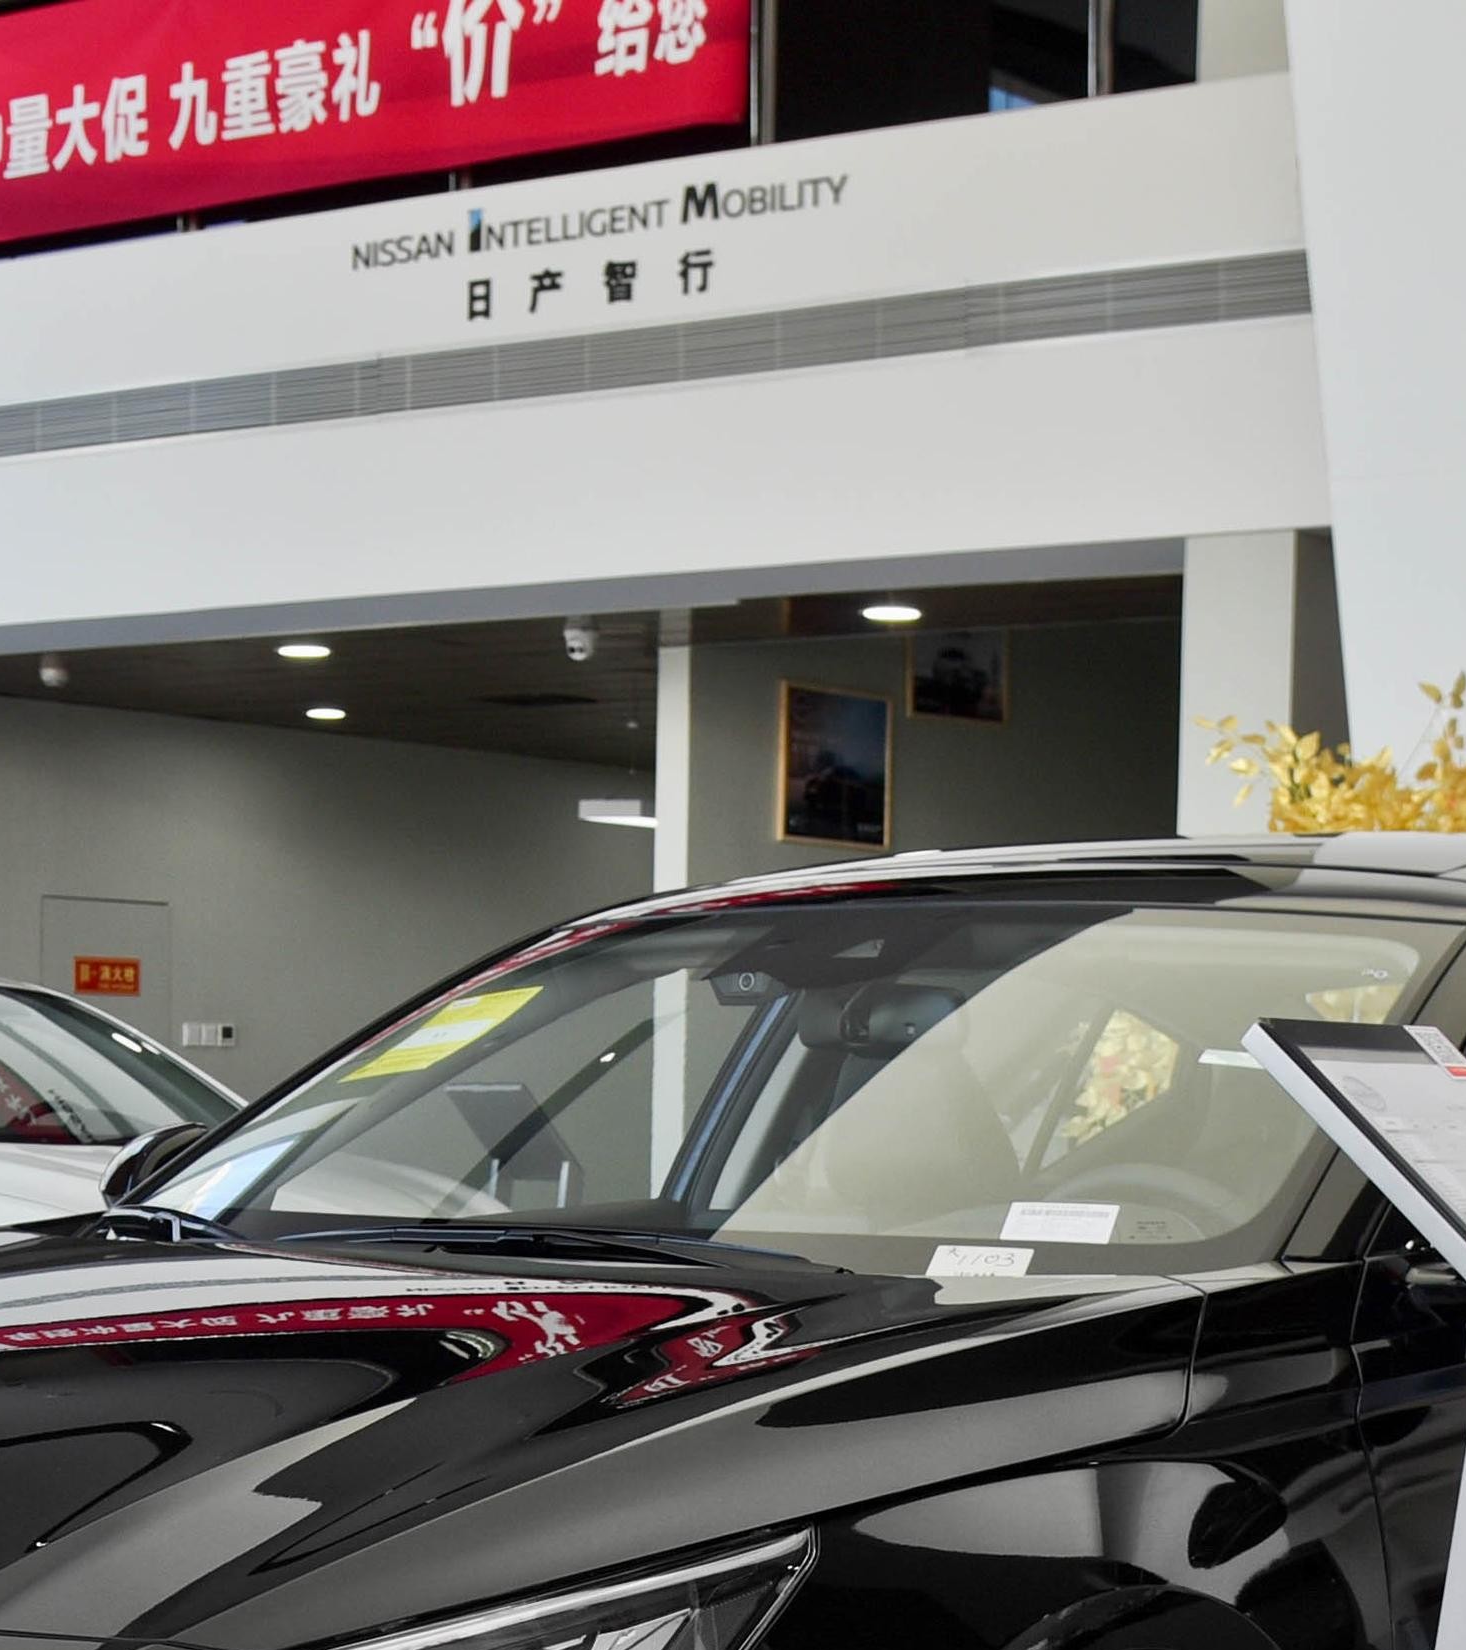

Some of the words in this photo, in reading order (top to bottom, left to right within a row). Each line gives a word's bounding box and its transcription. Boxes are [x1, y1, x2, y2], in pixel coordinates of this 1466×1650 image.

[168, 30, 382, 151] 九重豪礼
[352, 231, 456, 271] NISSAN
[468, 199, 671, 253] INTELLIGENT
[680, 175, 849, 224] MOBILITY
[467, 249, 715, 321] 日产智行
